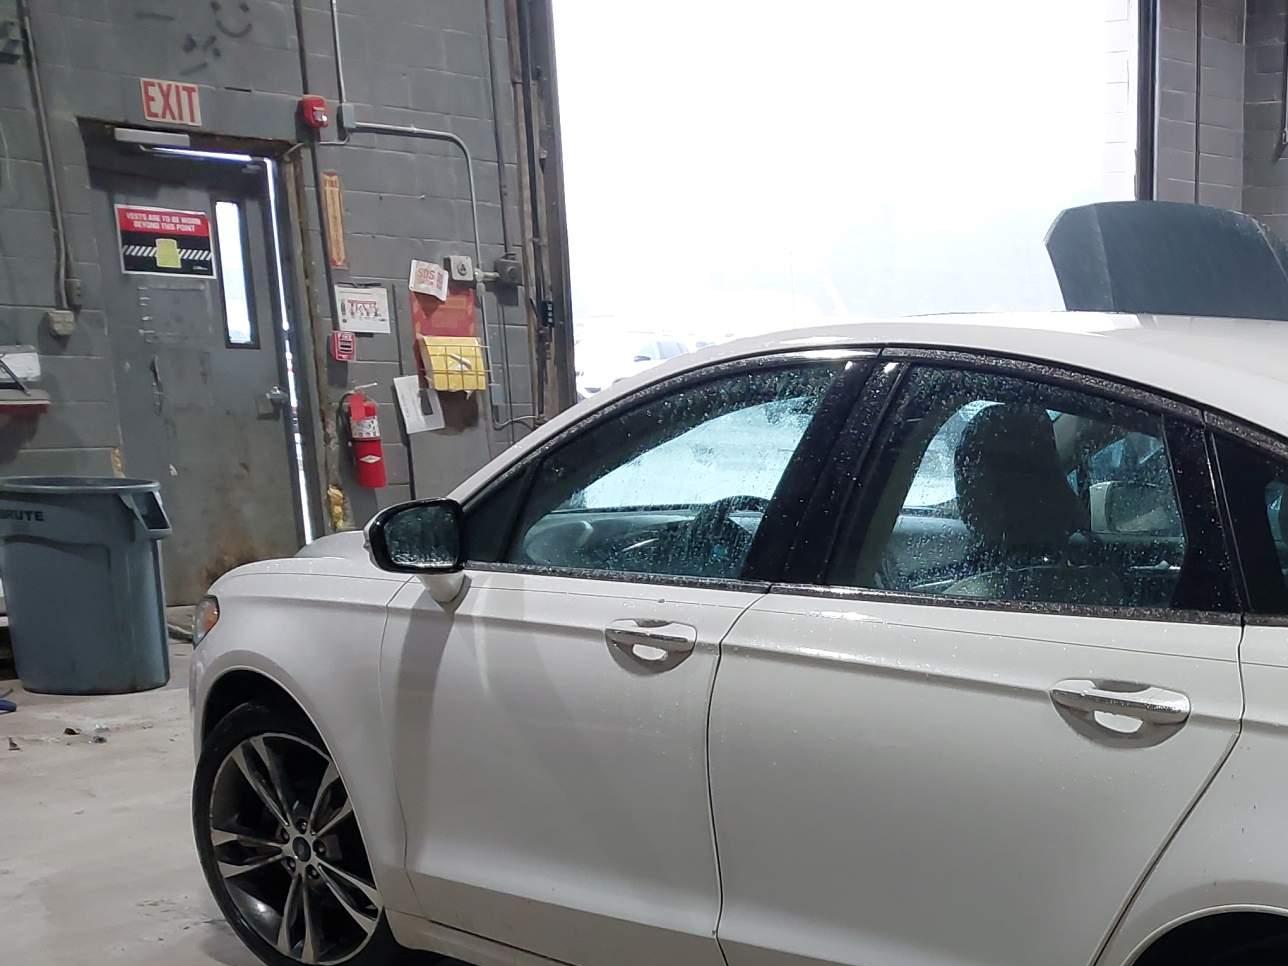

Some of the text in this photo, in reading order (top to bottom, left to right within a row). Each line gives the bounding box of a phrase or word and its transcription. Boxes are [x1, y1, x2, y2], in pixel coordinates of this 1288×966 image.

[143, 80, 196, 123] EXIT
[148, 214, 161, 222] ARE
[161, 215, 171, 223] TO
[176, 224, 195, 232] POINT
